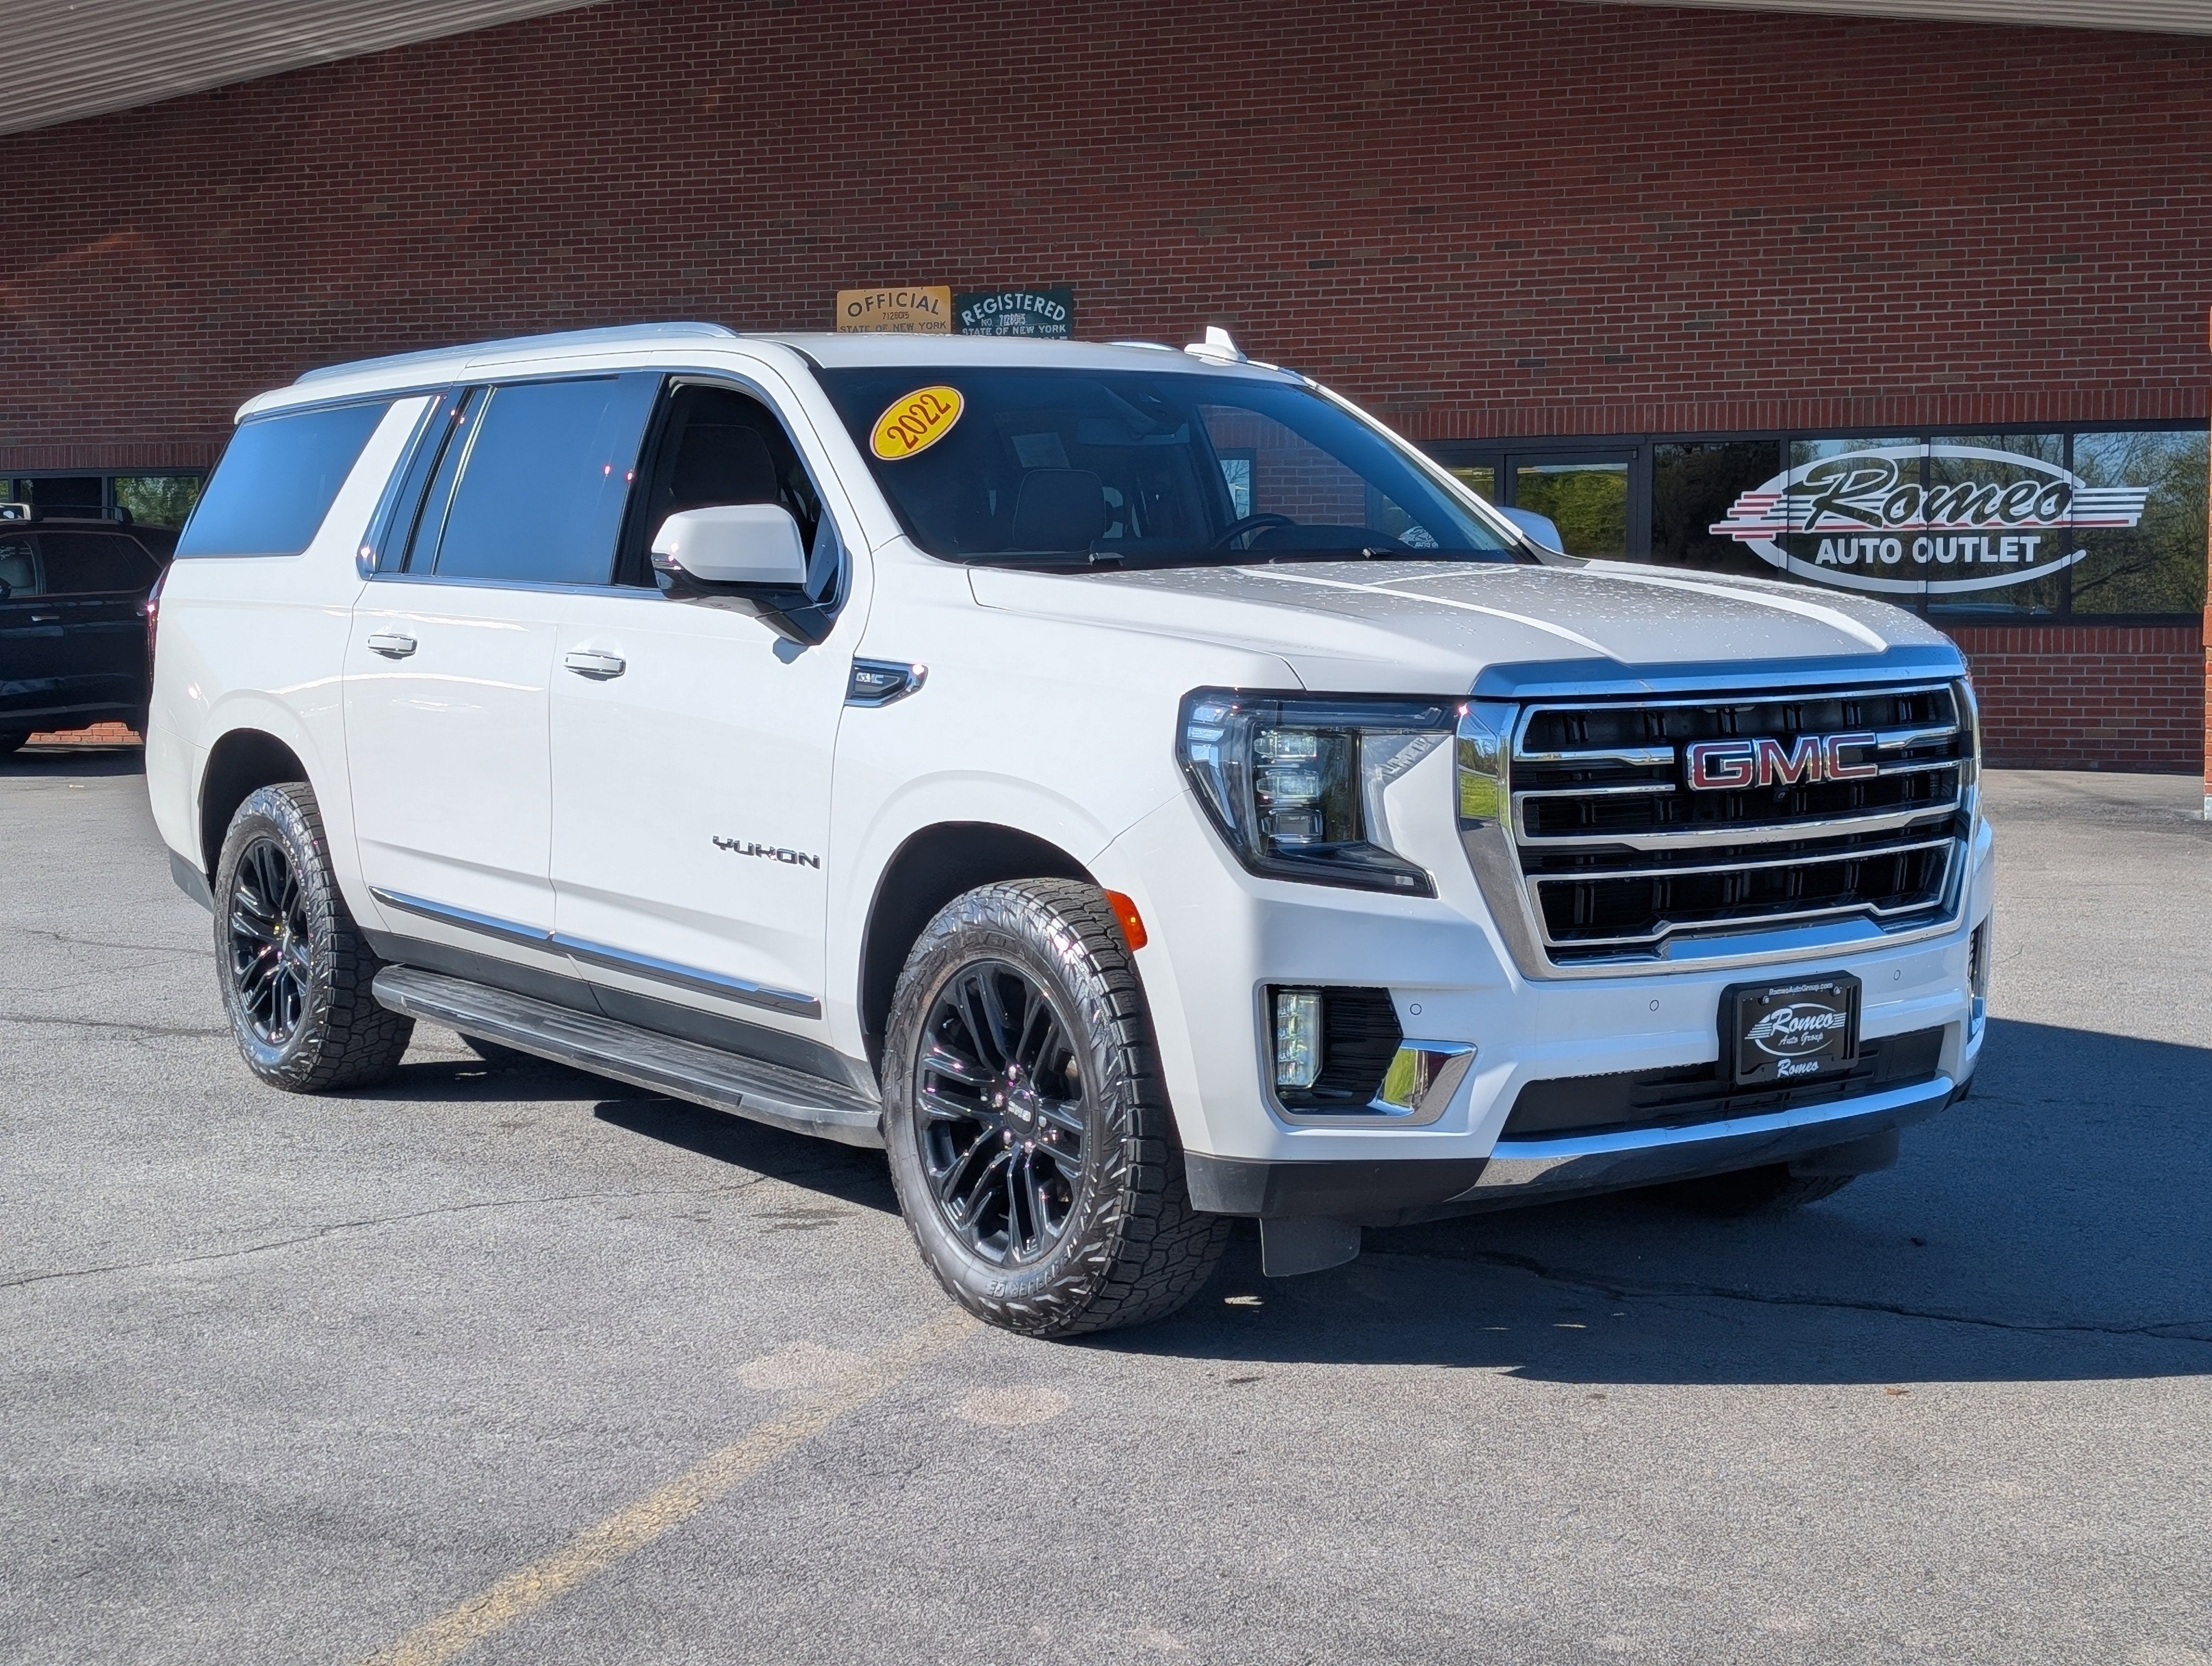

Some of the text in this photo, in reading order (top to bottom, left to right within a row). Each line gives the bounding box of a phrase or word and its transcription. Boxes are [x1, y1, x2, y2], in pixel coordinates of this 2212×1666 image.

[847, 292, 939, 317] OFFICIAL
[961, 293, 1066, 325] REGISTERED
[875, 324, 889, 332] OF
[893, 323, 915, 332] NEW
[918, 321, 947, 330] YORK
[962, 324, 1066, 336] STATE OF NEW YORK
[886, 394, 951, 450] 2022
[1803, 456, 2073, 534] Romeo
[1815, 536, 2041, 565] AUTO OUTLET
[1687, 732, 1878, 791] GMC
[712, 835, 820, 869] YUKON
[1770, 1008, 1834, 1036] Romeo
[1778, 1031, 1824, 1046] Auto Group
[1777, 1058, 1819, 1078] Romeo
